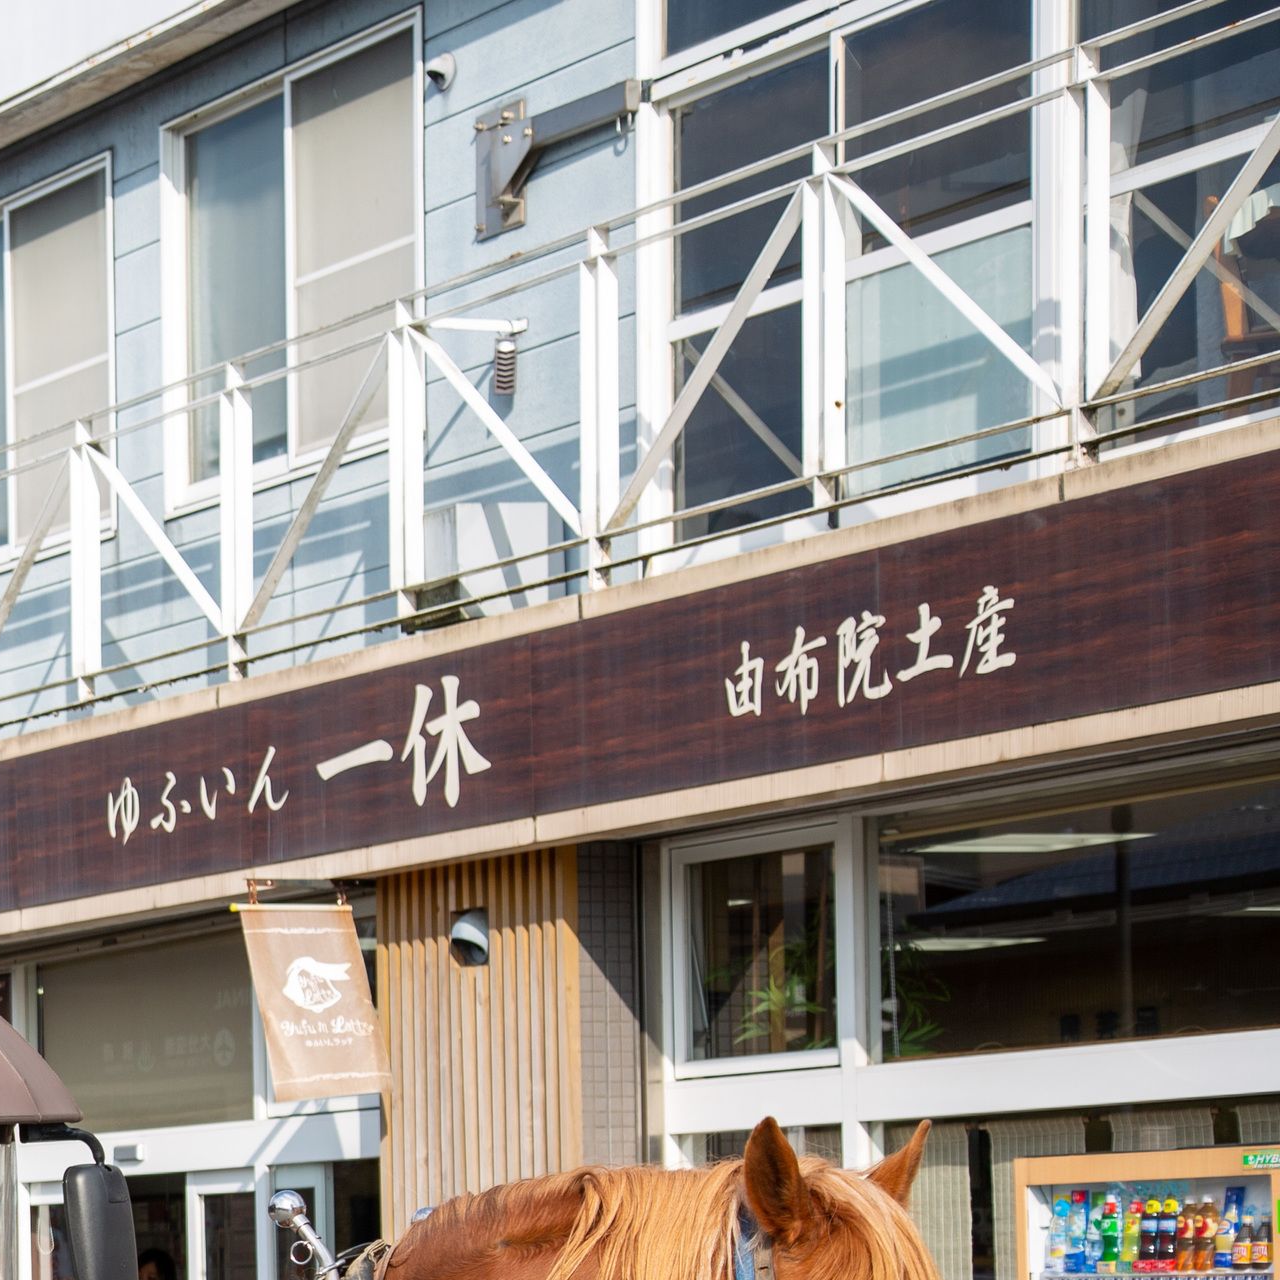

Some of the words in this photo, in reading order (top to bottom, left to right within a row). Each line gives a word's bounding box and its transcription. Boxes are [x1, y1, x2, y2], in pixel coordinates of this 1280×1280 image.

[724, 585, 1017, 718] 由布院土産
[107, 745, 290, 846] ゆふいん
[315, 674, 492, 809] 一休
